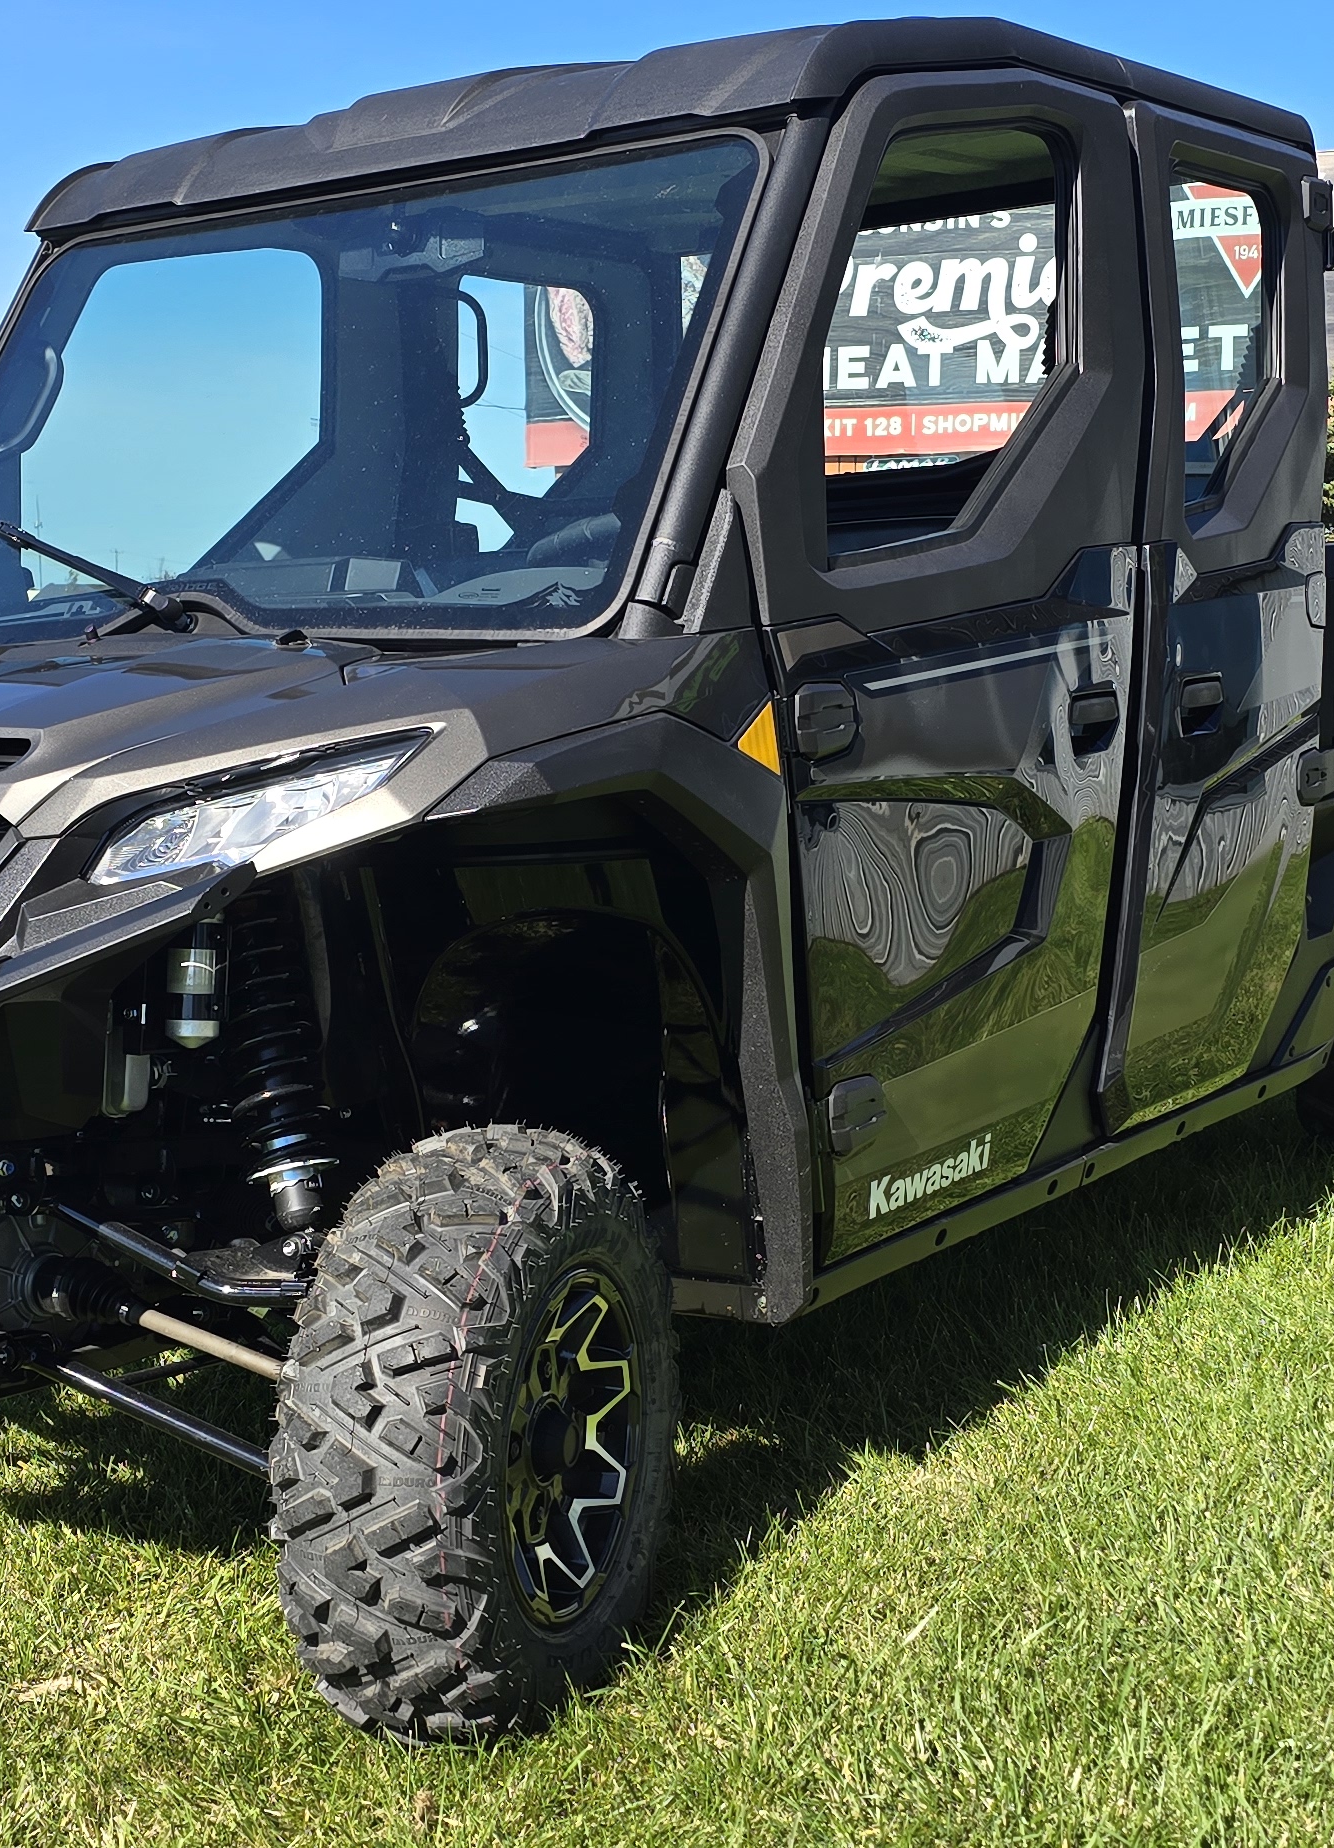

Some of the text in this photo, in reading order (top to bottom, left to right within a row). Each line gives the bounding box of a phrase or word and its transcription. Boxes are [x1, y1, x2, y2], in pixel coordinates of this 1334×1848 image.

[1176, 206, 1260, 230] MIESF
[1234, 245, 1262, 260] 194
[823, 343, 954, 391] EAT
[864, 416, 902, 437] 128
[869, 1132, 992, 1220] Kawasaki
[393, 1476, 436, 1488] DURO
[407, 1633, 440, 1645] DUR
